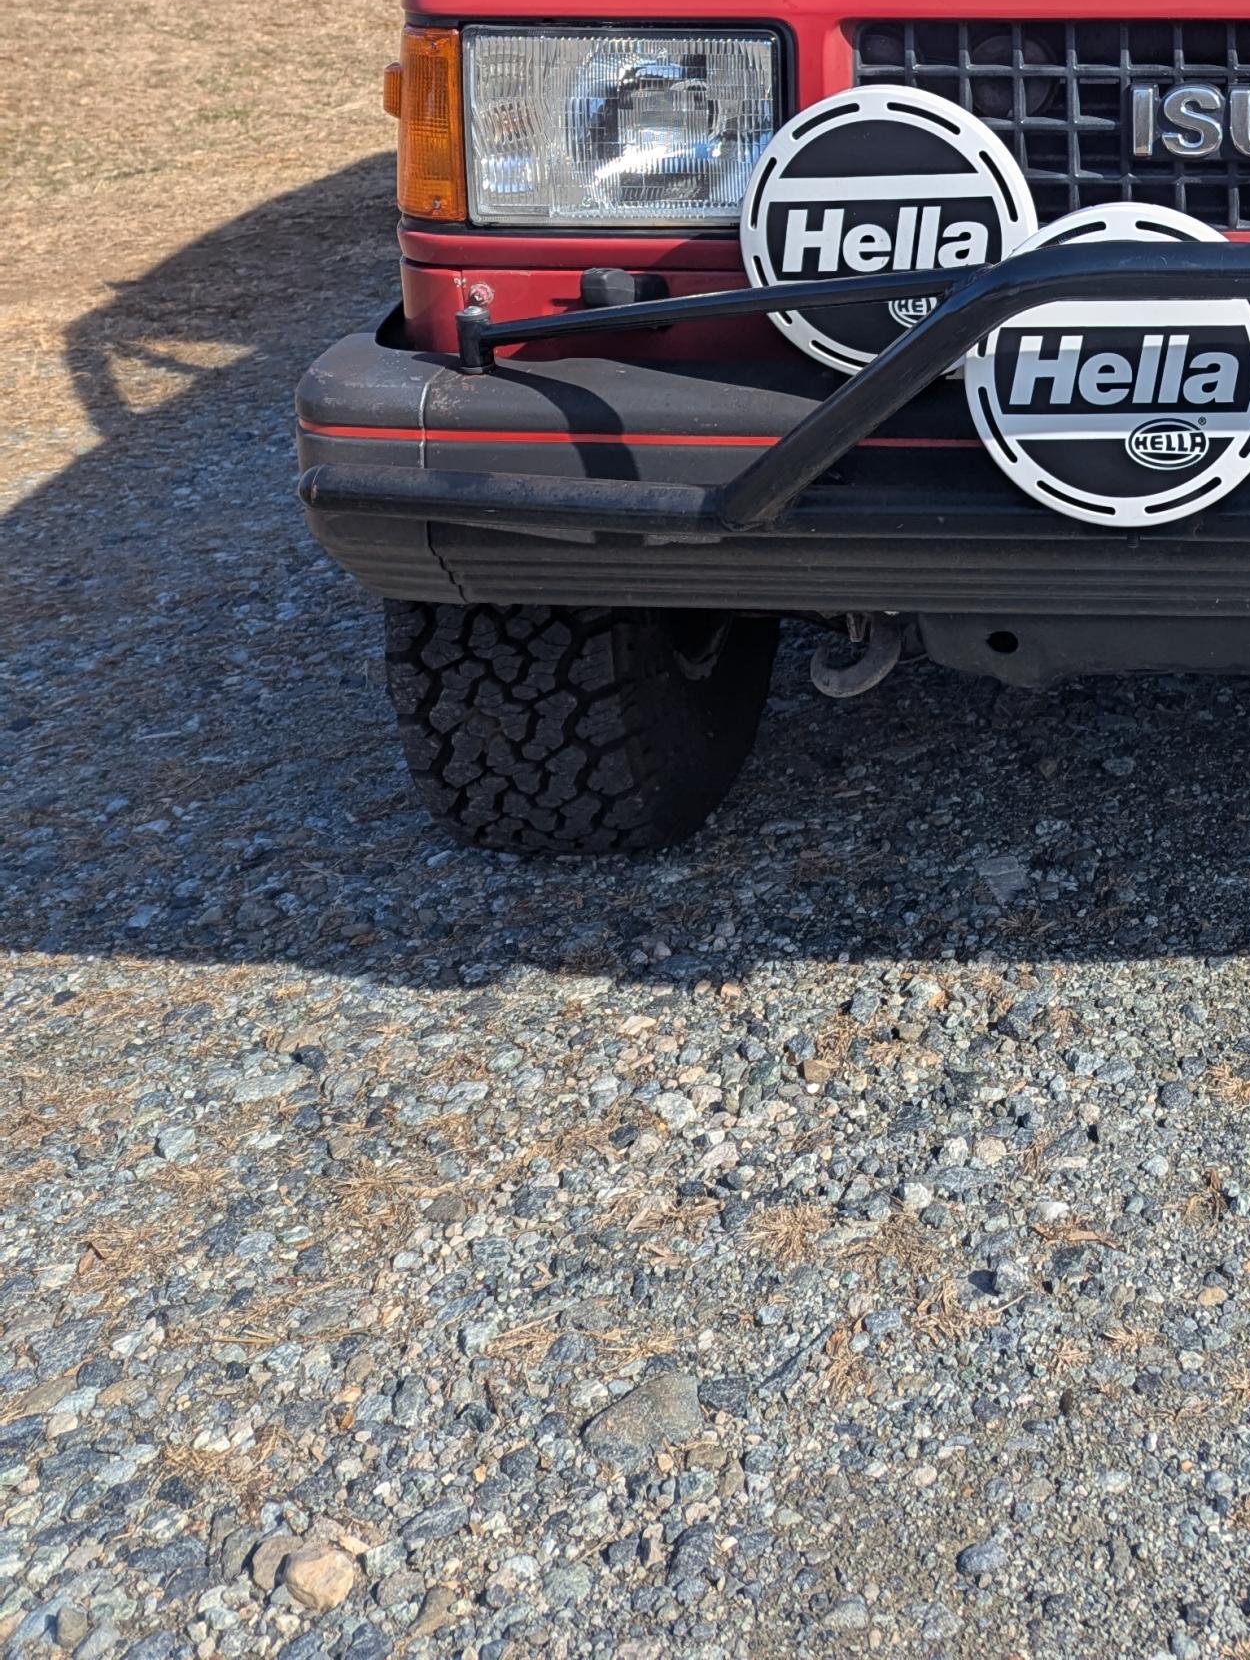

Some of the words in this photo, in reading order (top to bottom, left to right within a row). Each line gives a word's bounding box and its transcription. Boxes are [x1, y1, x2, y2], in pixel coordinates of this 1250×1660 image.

[782, 206, 989, 273] Hella
[1009, 334, 1240, 406] Hella
[1133, 431, 1207, 453] HELLA
